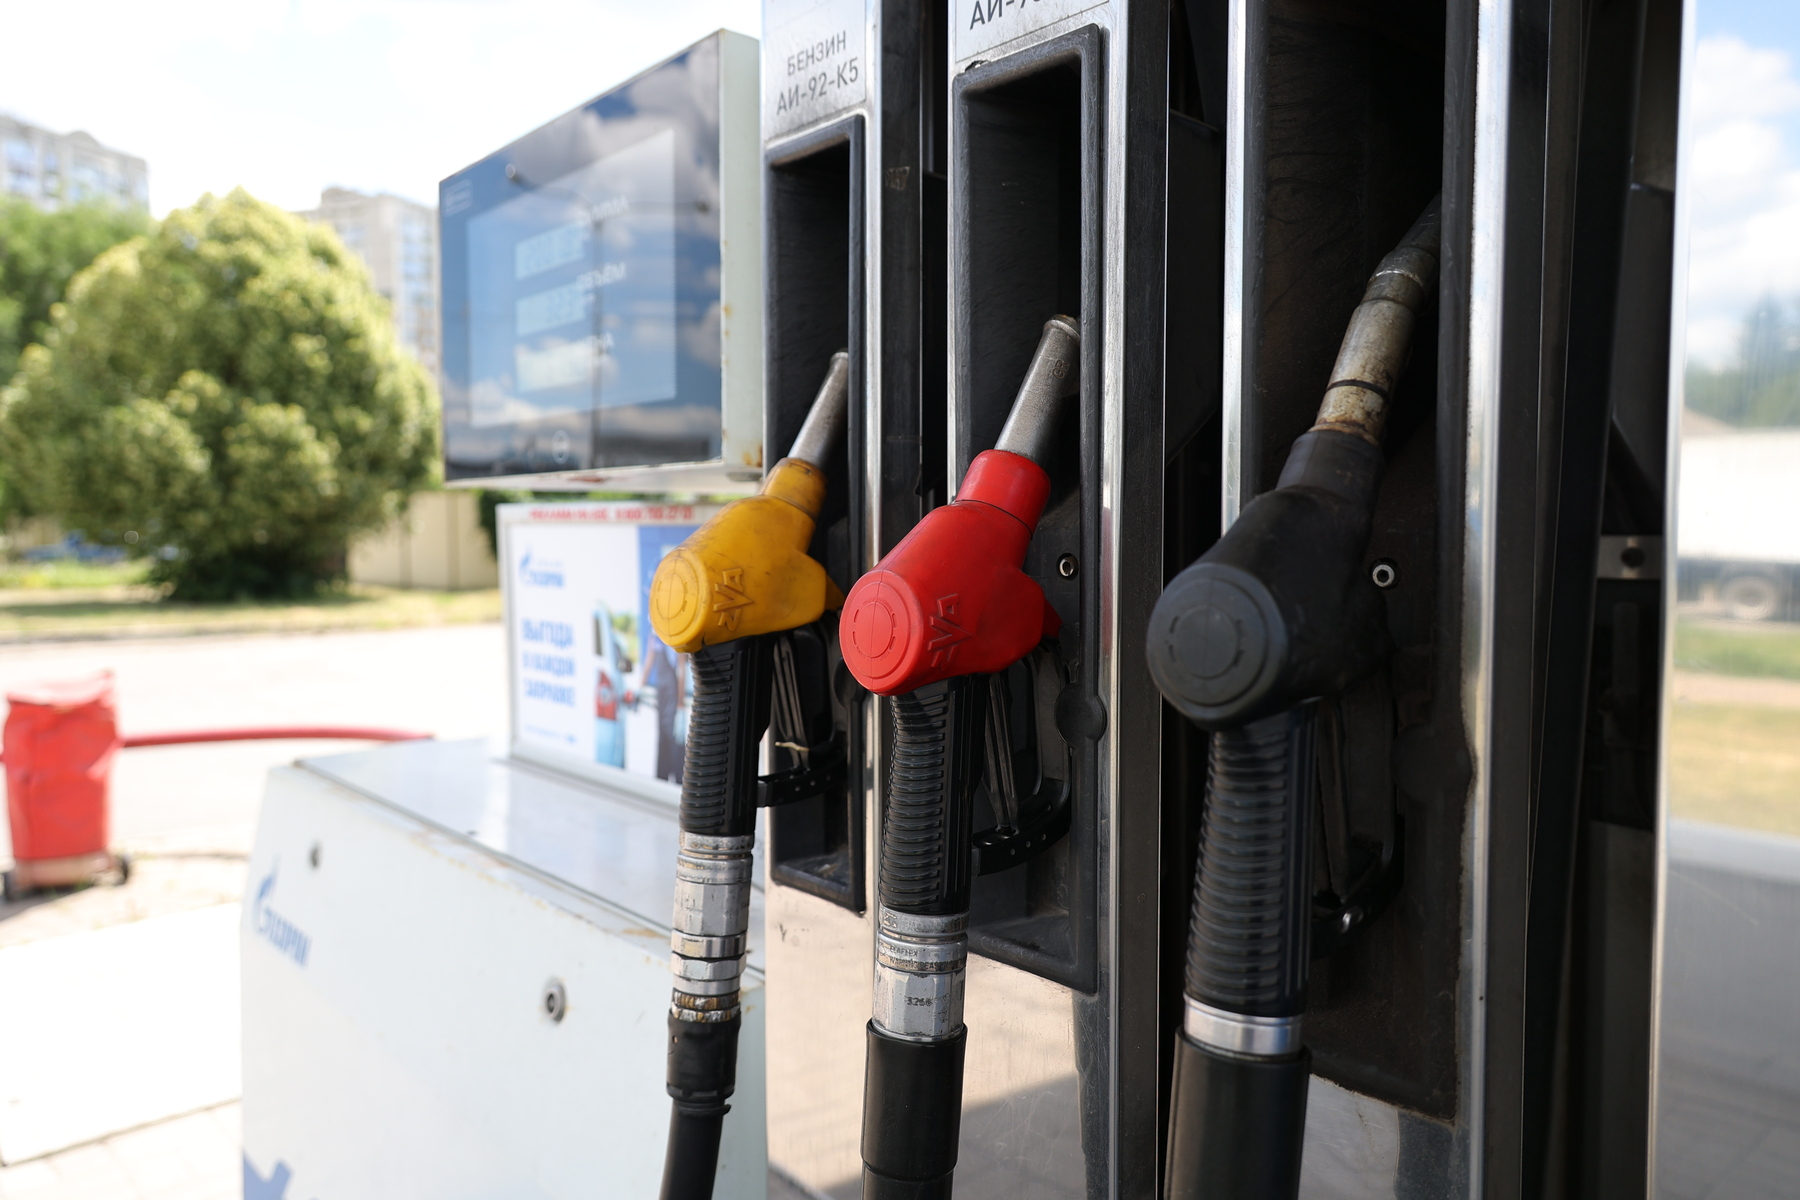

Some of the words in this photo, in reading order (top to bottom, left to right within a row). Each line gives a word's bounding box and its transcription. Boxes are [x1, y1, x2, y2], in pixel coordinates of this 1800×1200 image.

[970, 0, 1041, 31] АИ-
[787, 30, 848, 77] БЕНЗИН
[776, 57, 860, 116] АИ-92-К5
